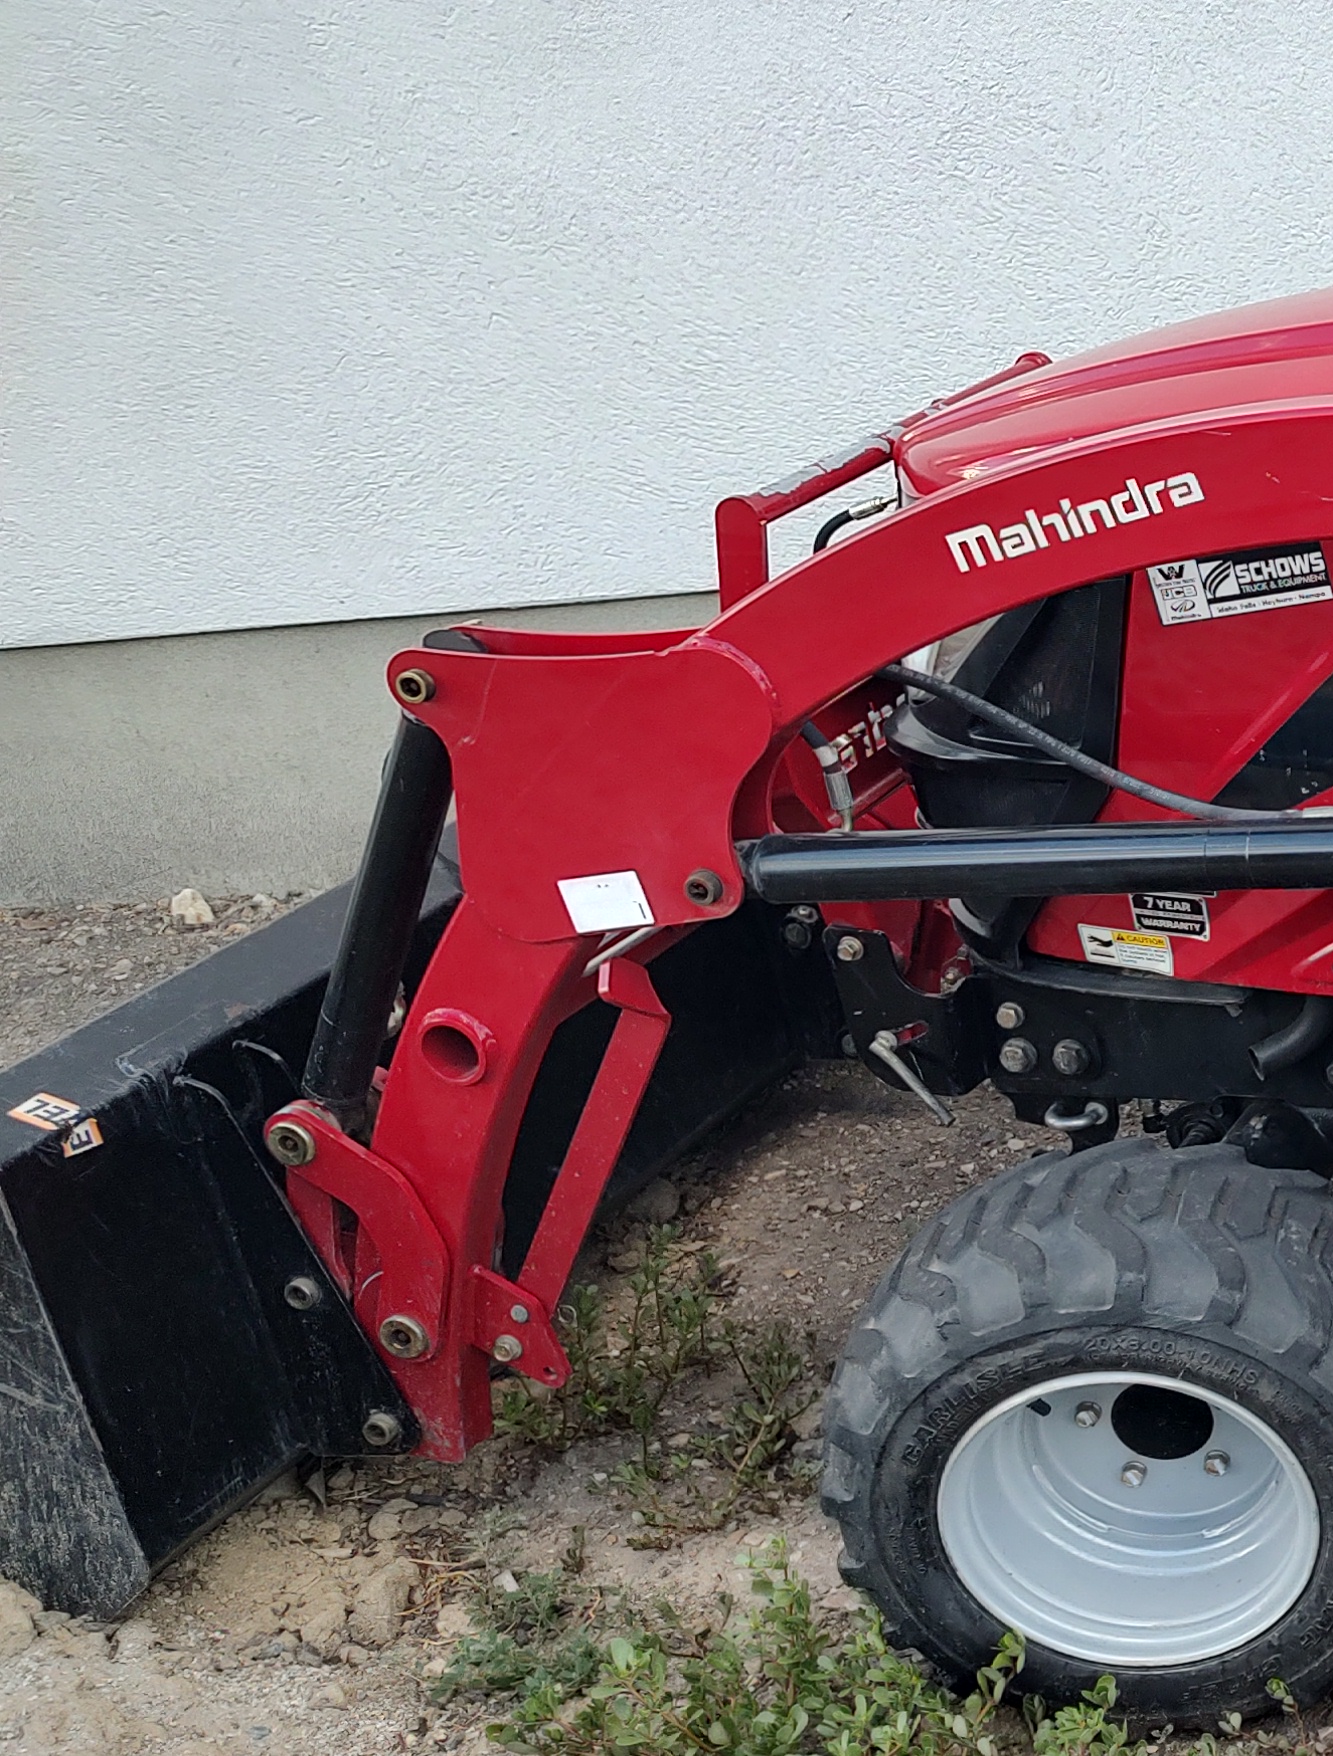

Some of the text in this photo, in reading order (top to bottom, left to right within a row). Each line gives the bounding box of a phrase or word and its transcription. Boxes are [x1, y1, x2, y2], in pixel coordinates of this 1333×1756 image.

[945, 472, 1205, 573] Mahindra
[1235, 551, 1326, 584] SCHOWS
[1161, 585, 1198, 600] JCB
[1241, 573, 1327, 594] TRUCK & EQUIPMENT
[1143, 896, 1191, 912] 7 YEAR
[1141, 916, 1203, 931] WARRANTY
[1126, 935, 1165, 947] CAUTION
[901, 1350, 1048, 1467] CARLISLE
